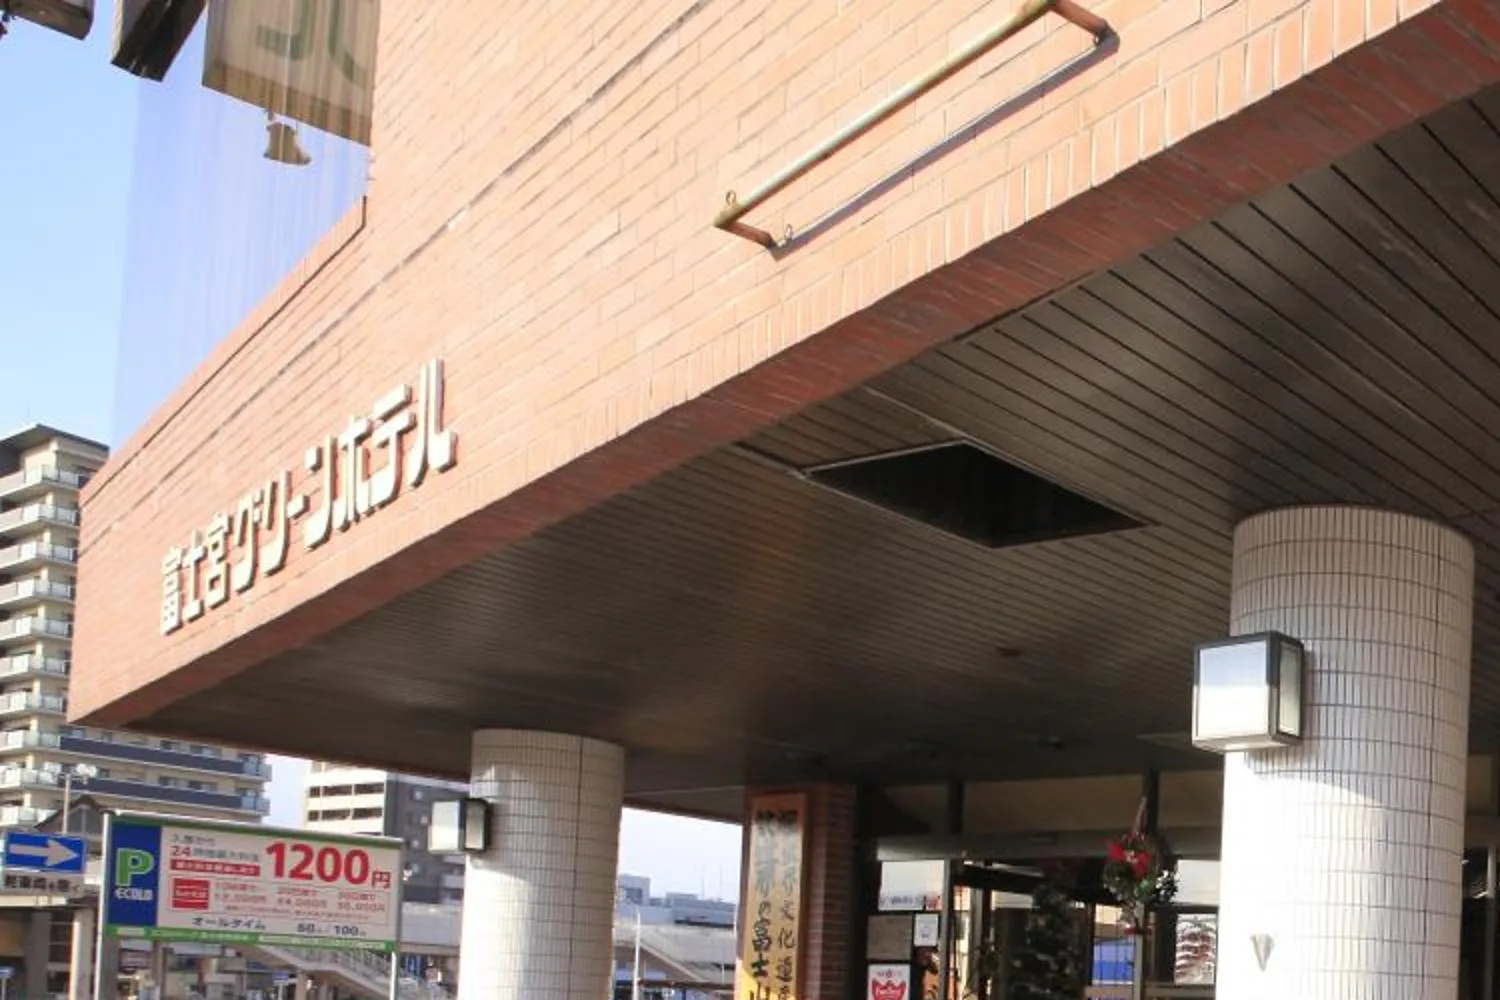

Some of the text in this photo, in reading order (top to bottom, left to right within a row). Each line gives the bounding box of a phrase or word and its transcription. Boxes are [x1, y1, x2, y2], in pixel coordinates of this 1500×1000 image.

[161, 357, 457, 635] 富士宮グリーンホテル
[115, 848, 154, 886] P
[265, 841, 391, 889] 1200円
